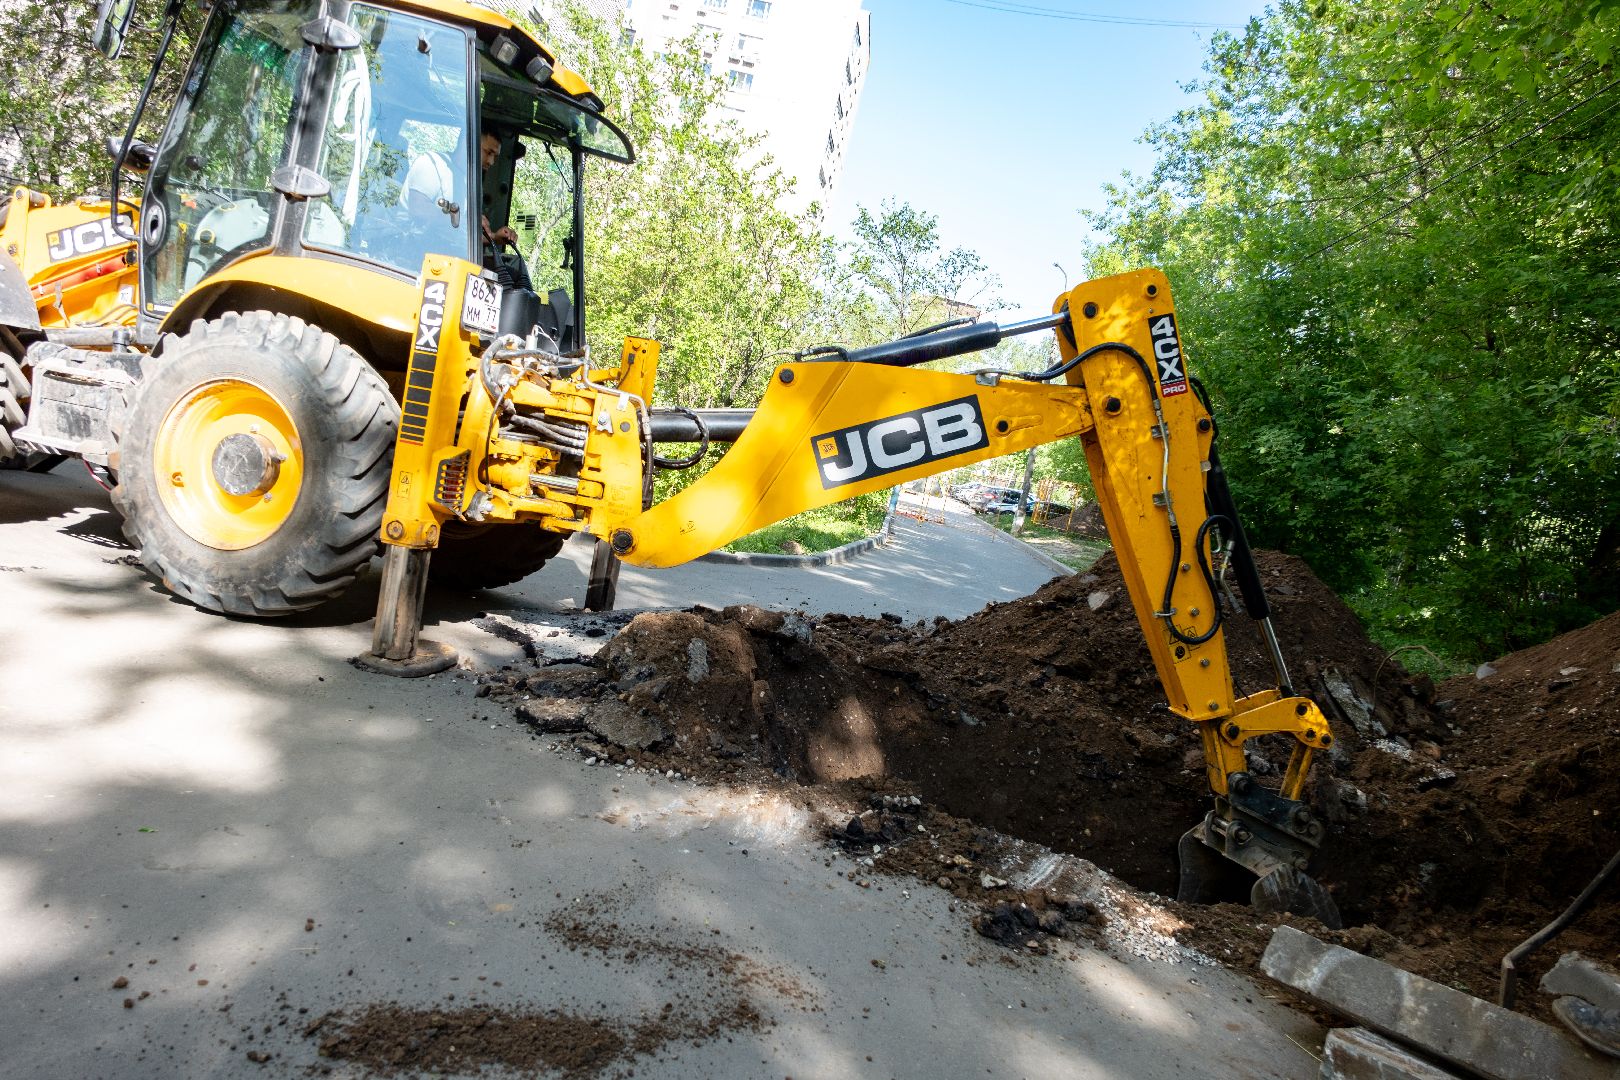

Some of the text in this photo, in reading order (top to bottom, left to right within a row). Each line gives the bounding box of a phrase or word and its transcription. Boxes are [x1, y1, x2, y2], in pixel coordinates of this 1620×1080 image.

[471, 279, 497, 305] 8629
[486, 307, 497, 322] 77
[415, 282, 446, 348] 4CX
[1151, 316, 1184, 381] 4CX
[1163, 384, 1187, 395] PRO
[823, 402, 983, 482] JCB
